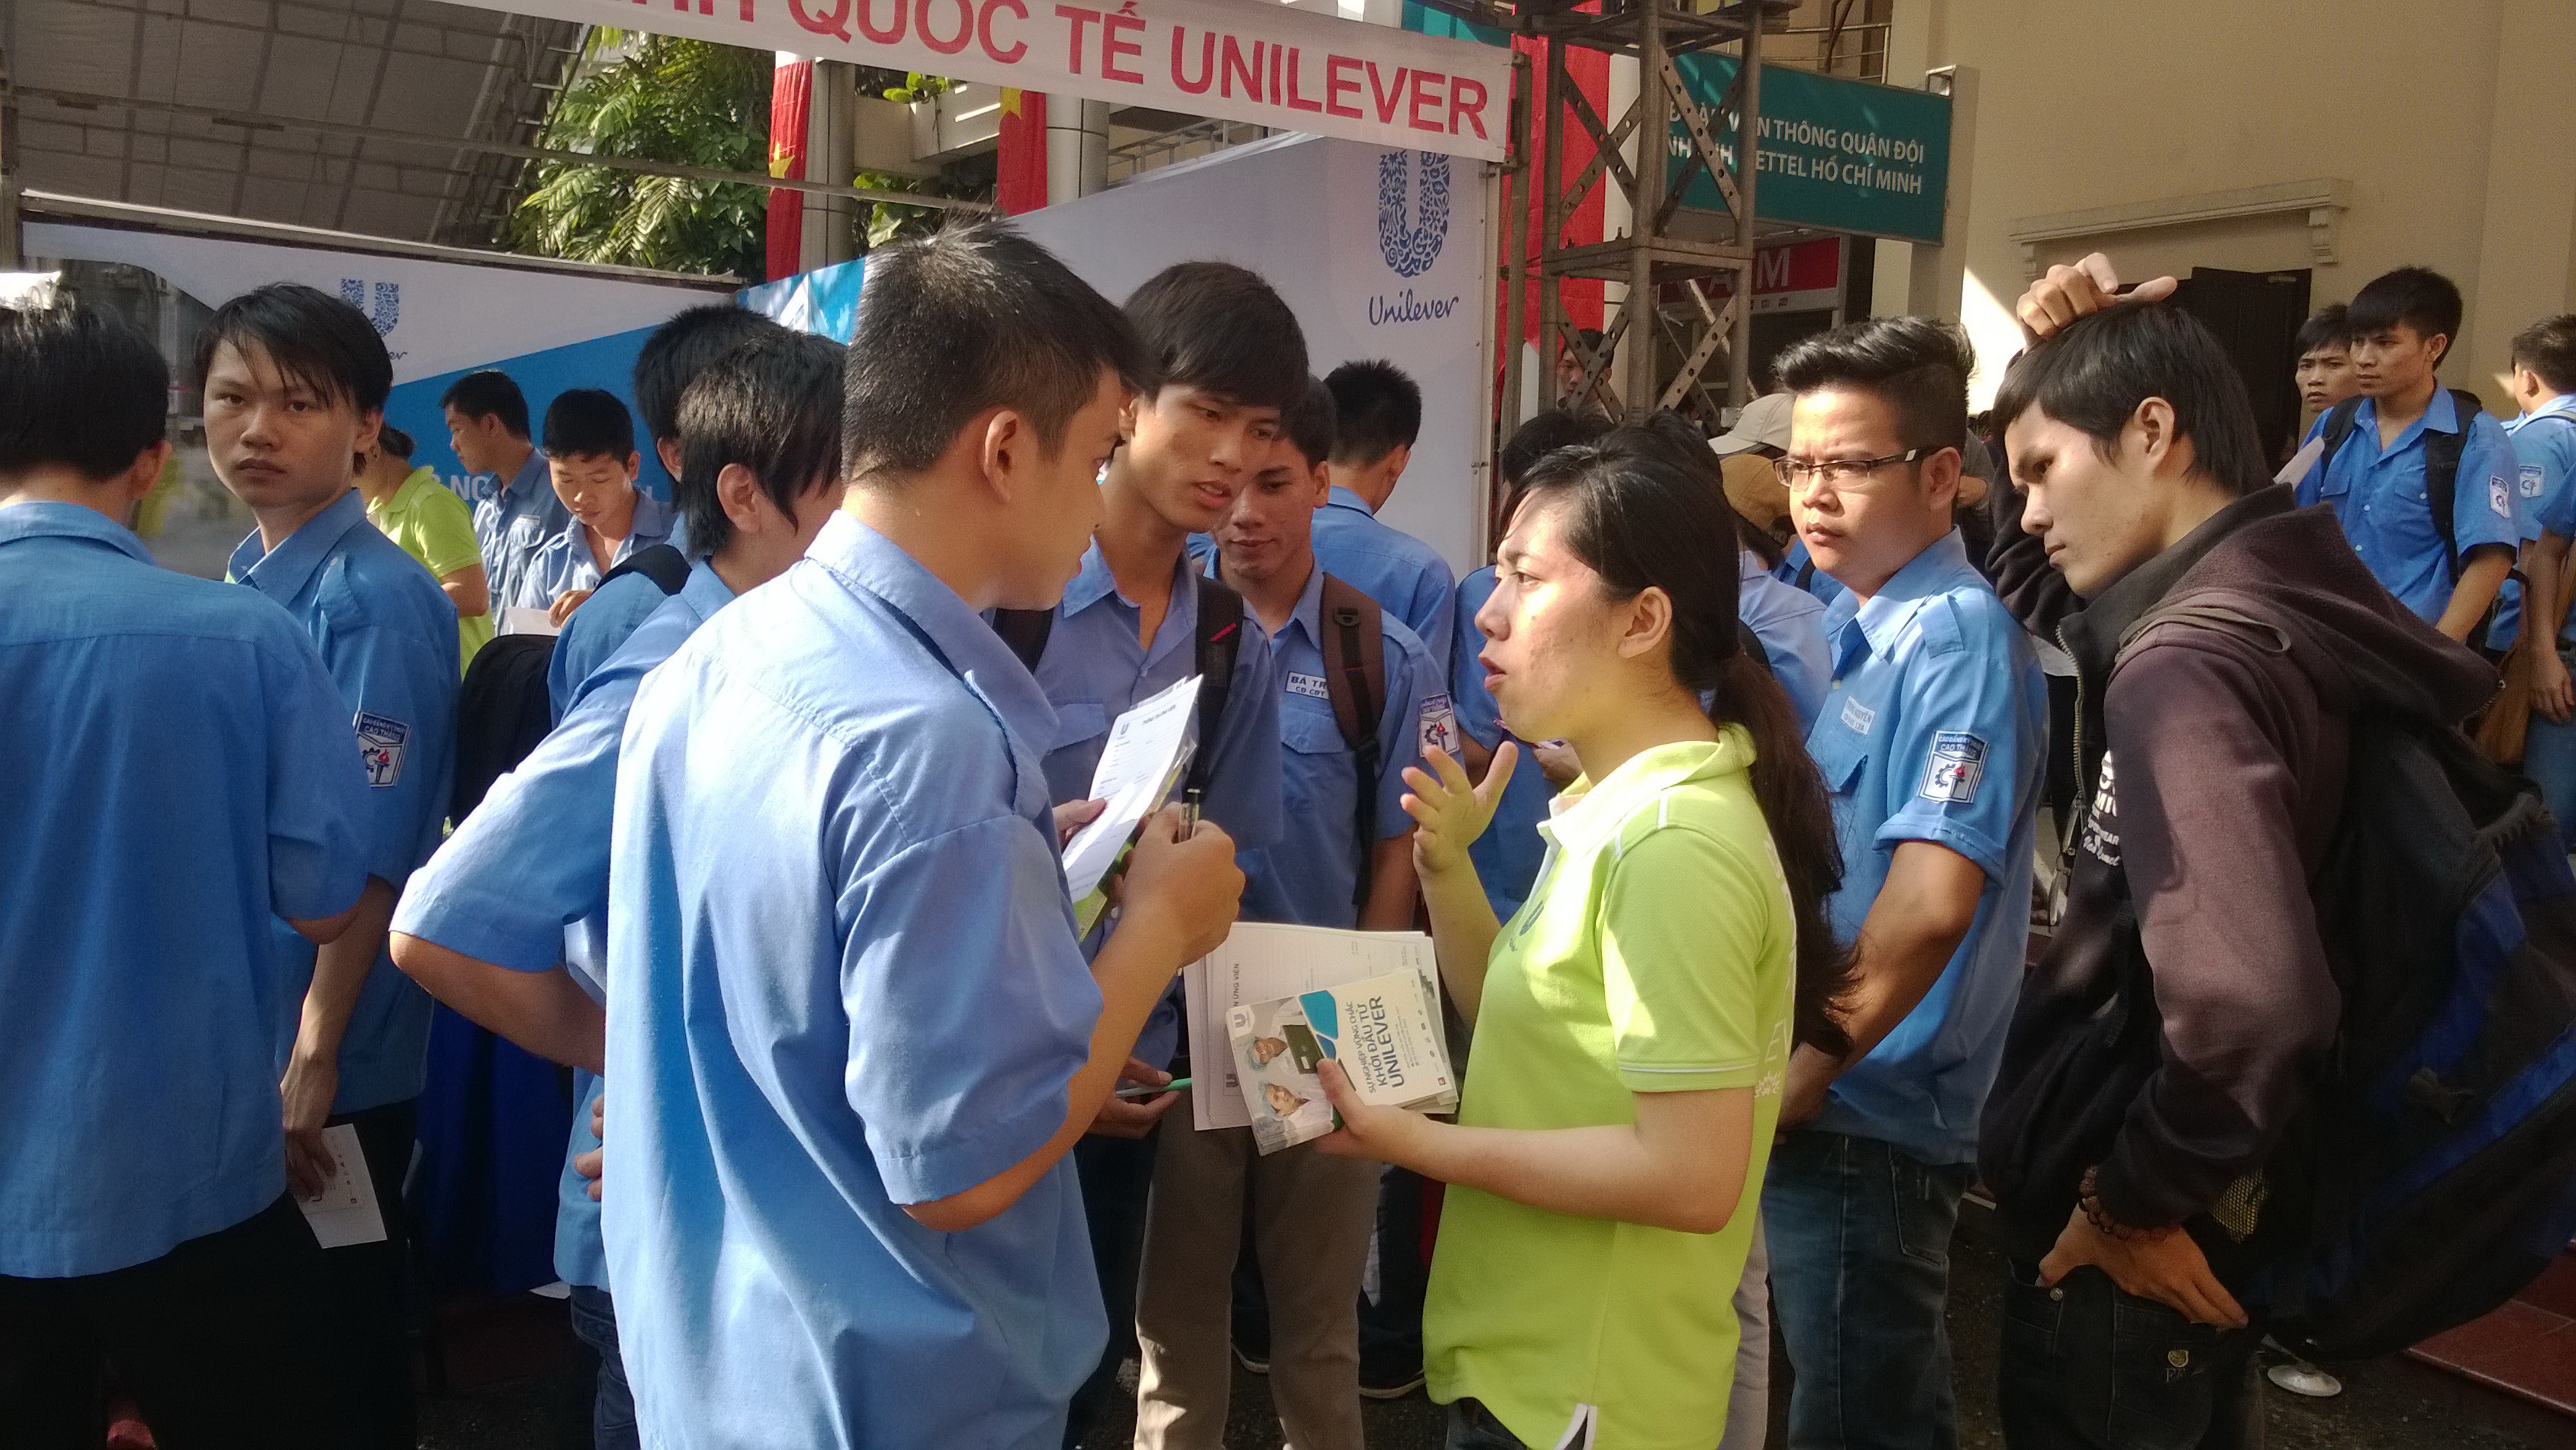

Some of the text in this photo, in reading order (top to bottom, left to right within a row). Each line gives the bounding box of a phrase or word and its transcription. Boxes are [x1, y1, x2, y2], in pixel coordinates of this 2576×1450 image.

[1054, 1, 1147, 85] TẾ
[1170, 25, 1489, 141] UNILEVER
[1774, 120, 1836, 149] THÔNG
[1841, 132, 1890, 158] QUÂN
[1893, 139, 1924, 168] ĐỘI
[1755, 149, 1807, 178] ETTEL
[1842, 162, 1874, 187] CHÍ
[1875, 168, 1922, 195] MINH
[1369, 288, 1459, 326] Unilever
[1313, 679, 1327, 689] TR
[1368, 995, 1405, 1088] UNILEVER
